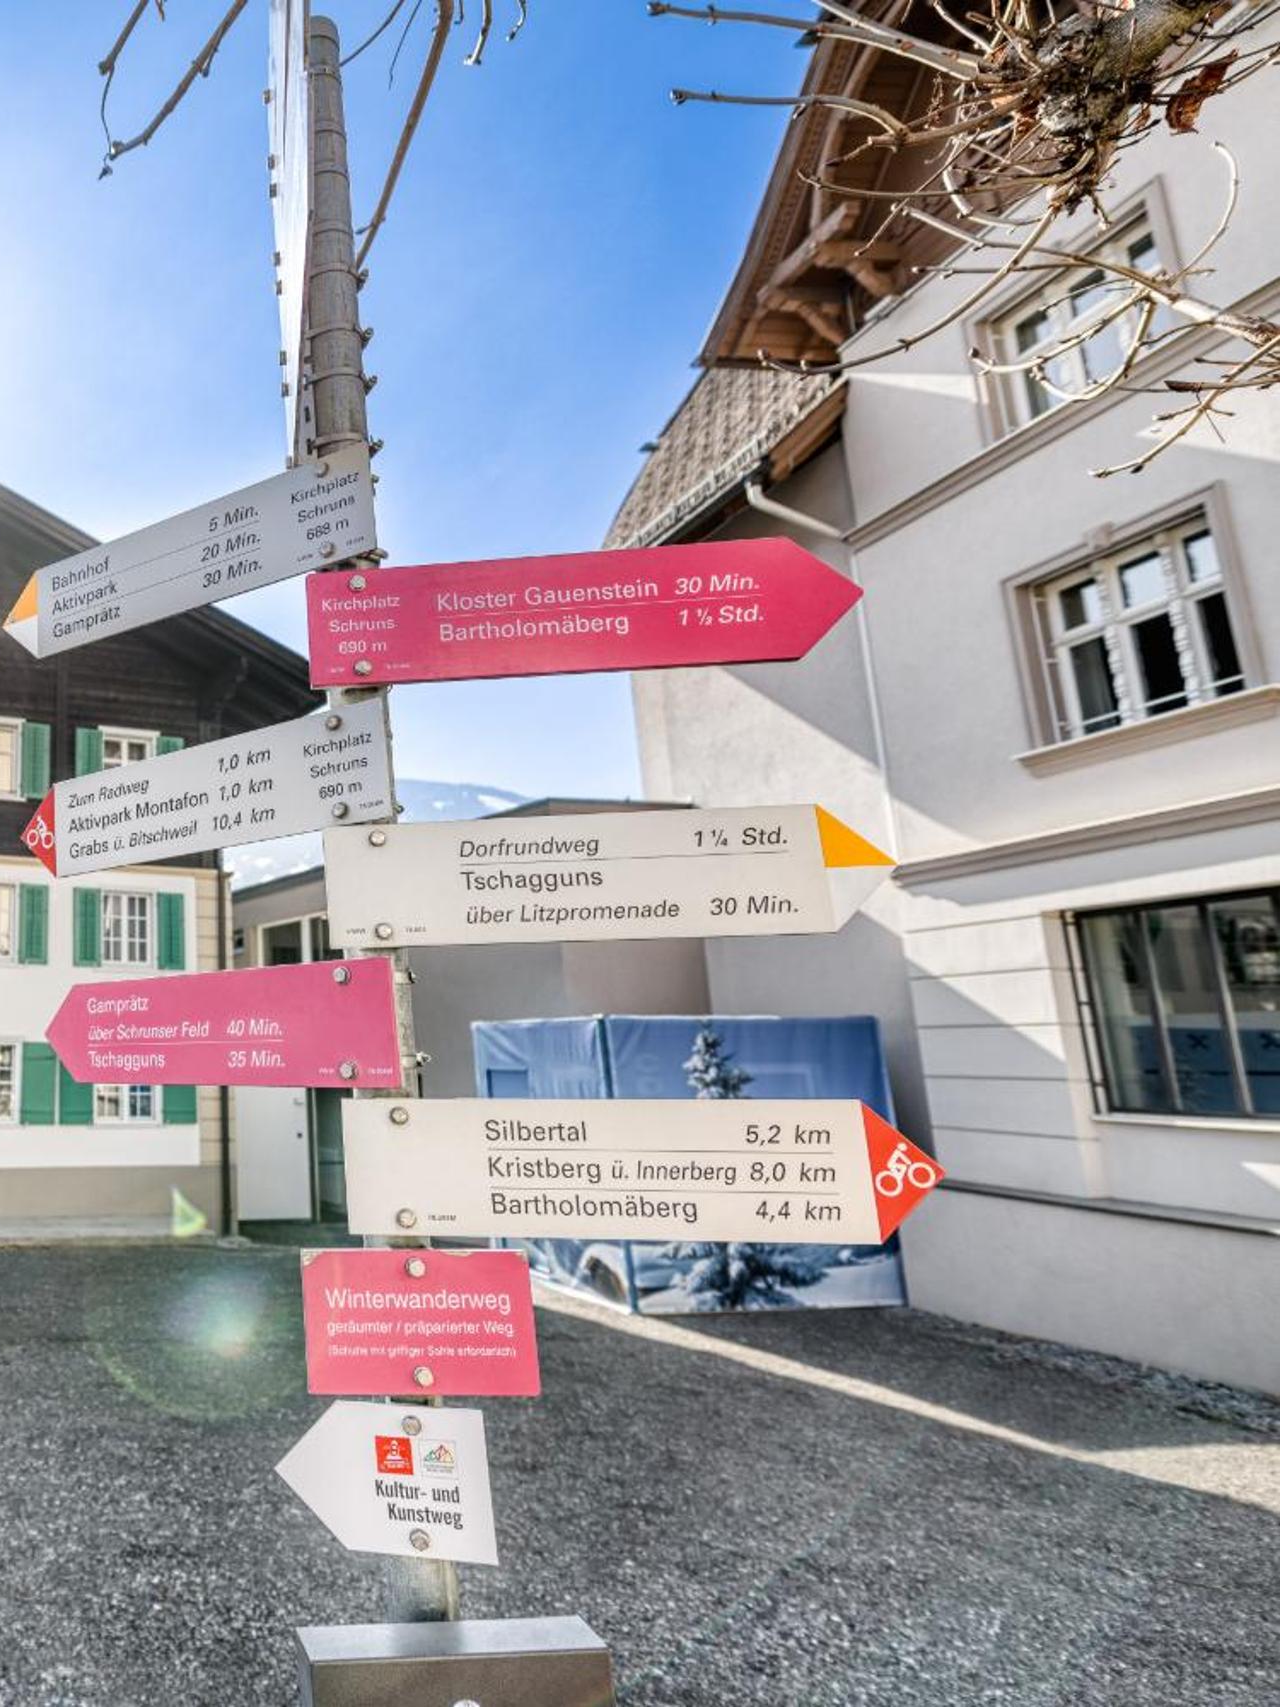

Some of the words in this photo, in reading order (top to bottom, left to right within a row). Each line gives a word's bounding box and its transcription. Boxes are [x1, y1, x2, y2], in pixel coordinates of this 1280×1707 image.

[290, 472, 360, 505] Kirchplatz
[298, 495, 355, 523] Schruns
[306, 522, 331, 540] 688
[335, 518, 350, 531] m
[52, 556, 109, 592] Bahnhof
[209, 516, 218, 532] 5
[223, 505, 259, 528] Min.
[52, 580, 117, 615] Aktivpark
[201, 543, 220, 562] 20
[225, 532, 261, 553] Min.
[202, 570, 221, 588] 30
[226, 559, 263, 580] Min.
[321, 594, 401, 614] Kirchplatz
[436, 589, 516, 612] Kloster
[524, 579, 660, 607] Gauenstein
[674, 577, 702, 596] 30
[708, 572, 761, 593] Min.
[329, 618, 394, 634] Schruns
[439, 611, 631, 643] Bartholomäberg
[718, 604, 765, 624] Std.
[338, 639, 368, 655] 690
[371, 639, 387, 653] m
[303, 733, 372, 757] Kirchplatz
[68, 792, 94, 808] Zum
[98, 779, 149, 801] Radweg
[218, 754, 240, 773] 1,0
[247, 749, 270, 766] km
[310, 757, 368, 778] Schruns
[319, 783, 344, 799] 690
[348, 781, 362, 793] m
[68, 807, 132, 833] Aktivpark
[136, 792, 209, 819] Montafon
[219, 783, 241, 800] 1,0
[248, 778, 273, 795] km
[70, 839, 109, 860] Grabs
[212, 810, 242, 830] 10,4
[250, 807, 276, 824] km
[459, 836, 600, 860] Dorfrundweg
[742, 826, 788, 846] Std.
[460, 868, 604, 894] Tschagguns
[466, 905, 512, 925] über
[520, 900, 681, 924] Litzpromenade
[709, 896, 738, 917] 30
[747, 895, 800, 915] Min.
[88, 1025, 115, 1041] über
[117, 1024, 178, 1040] Schrunser
[181, 1020, 210, 1037] Feld
[226, 1020, 245, 1036] 40
[249, 1019, 283, 1036] Min.
[88, 1051, 165, 1071] Tschagguns
[228, 1051, 246, 1068] 35
[250, 1050, 286, 1068] Min.
[484, 1120, 588, 1143] Silbertal
[745, 1125, 782, 1147] 5,2
[794, 1124, 832, 1145] km
[487, 1156, 602, 1184] Kristberg
[611, 1161, 630, 1181] ü.
[637, 1160, 737, 1186] Innerberg
[750, 1163, 787, 1186] 8,0
[799, 1162, 837, 1184] km
[491, 1192, 698, 1224] Bartholomäberg
[755, 1201, 792, 1223] 4,4
[805, 1200, 842, 1221] km
[325, 1288, 512, 1315] Winterwanderweg
[327, 1320, 393, 1337] geräumter
[404, 1319, 480, 1337] präparierter
[483, 1320, 514, 1338] Weg
[375, 1479, 427, 1500] Kultur-
[432, 1486, 461, 1504] und
[387, 1503, 464, 1530] Kunstweg
